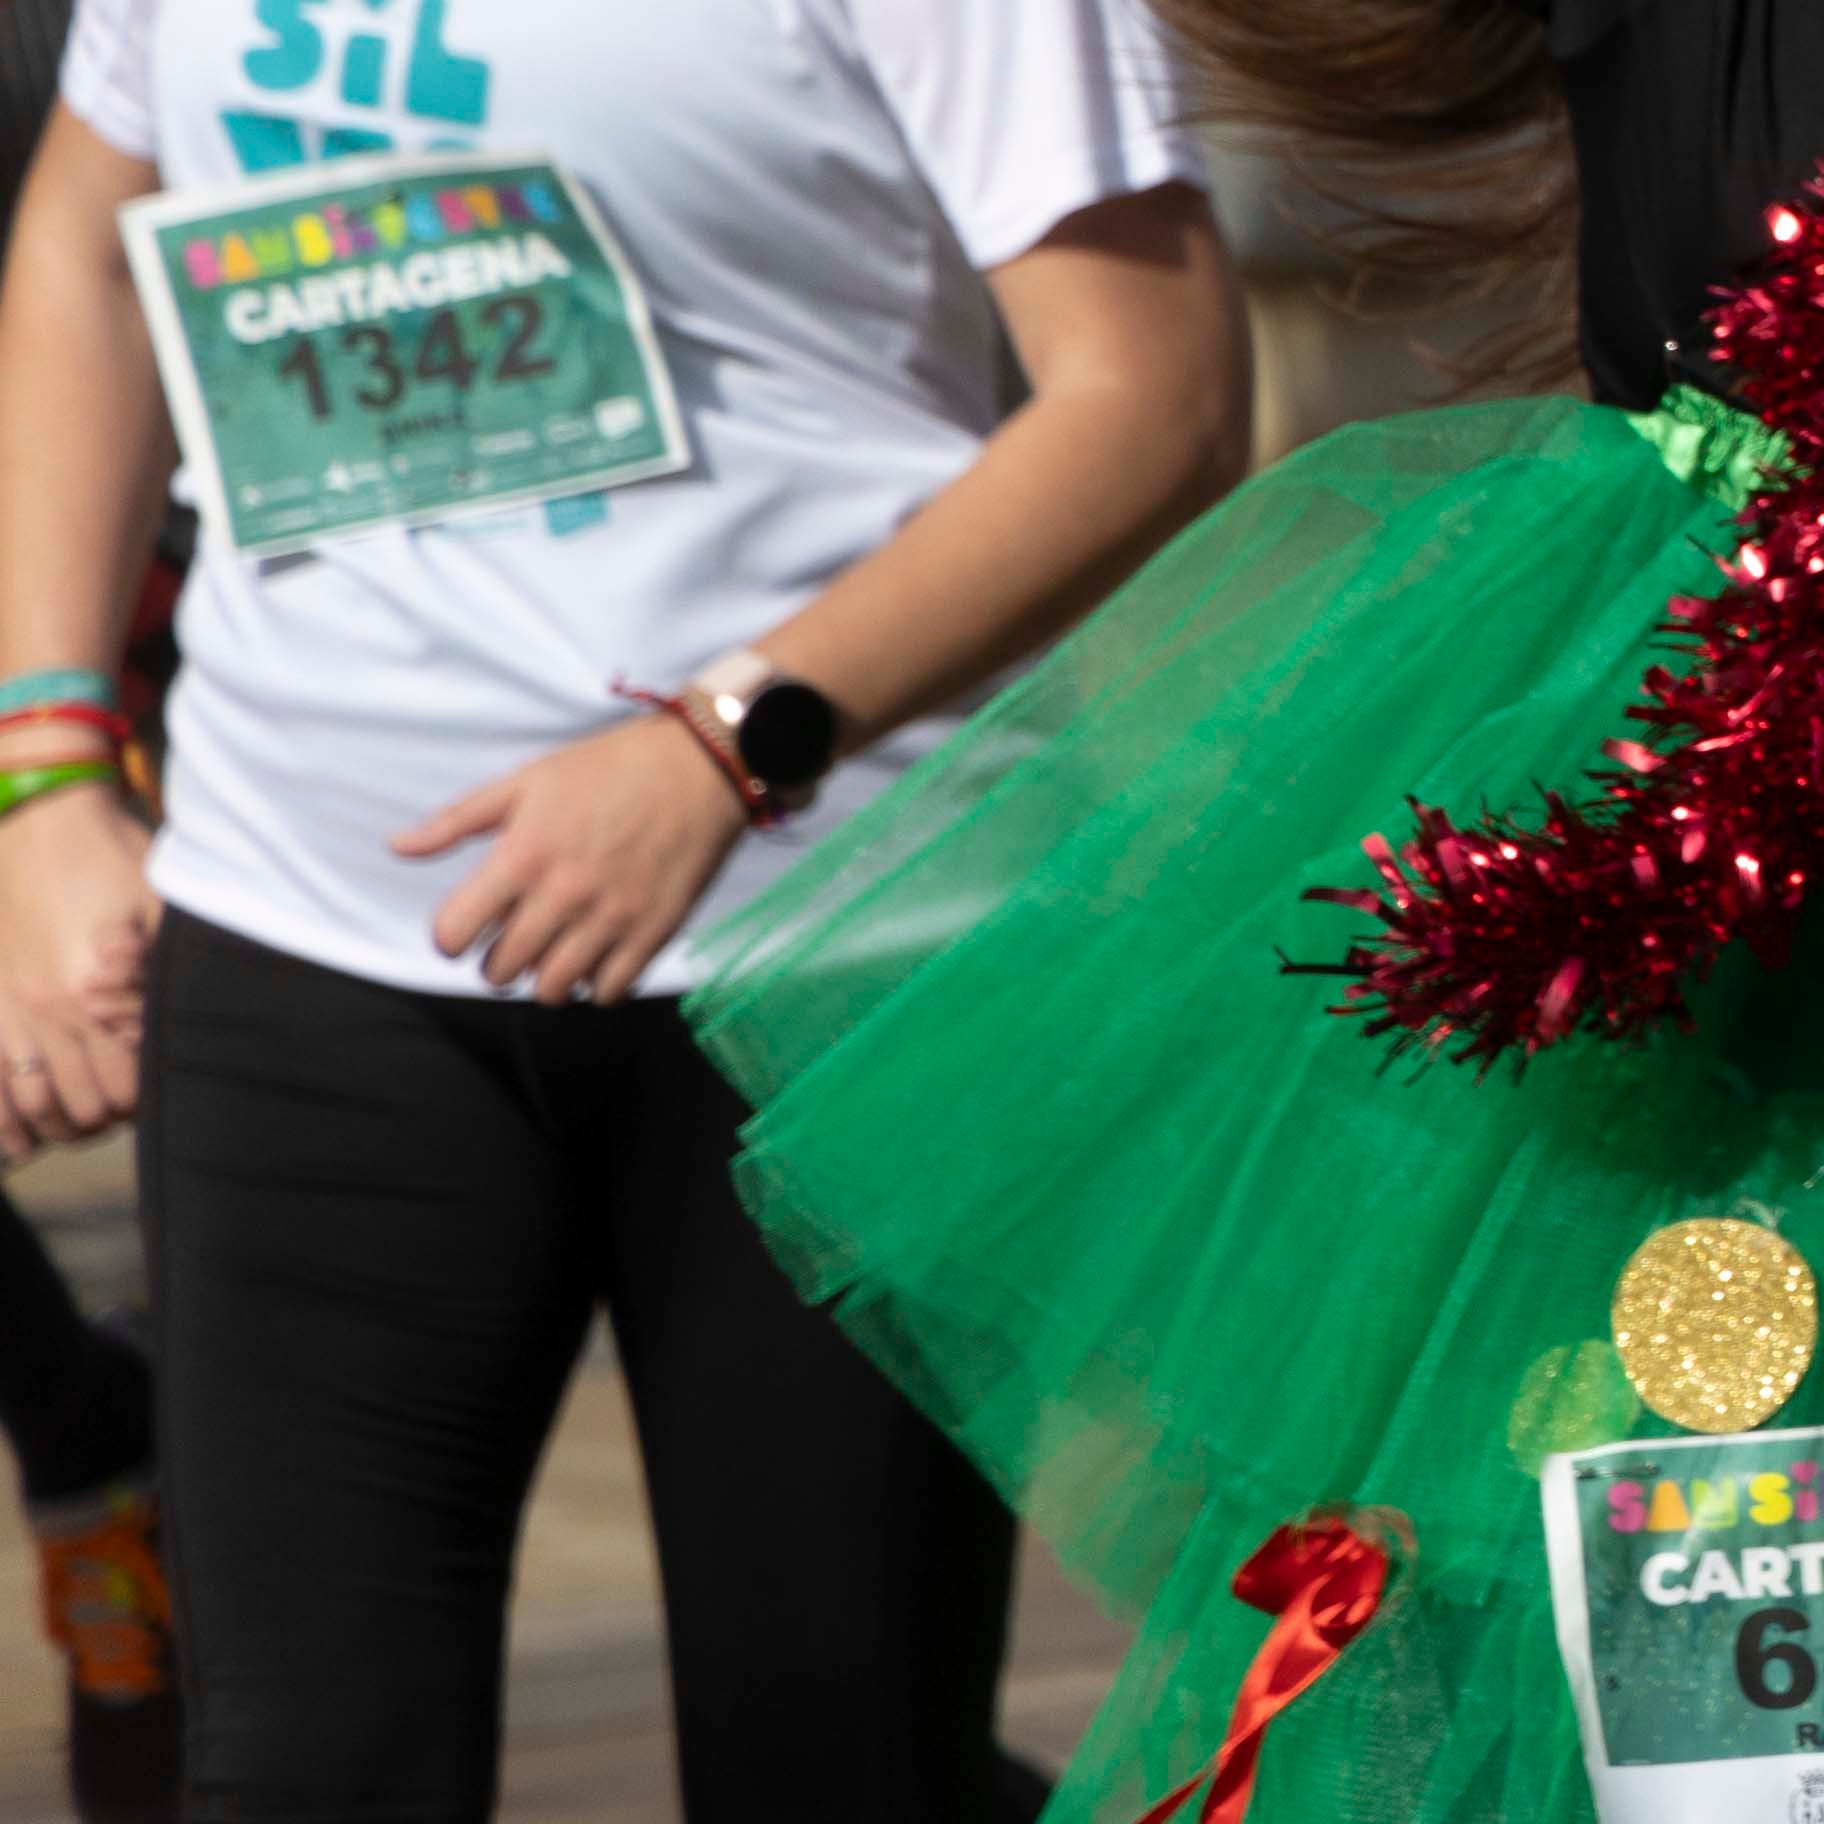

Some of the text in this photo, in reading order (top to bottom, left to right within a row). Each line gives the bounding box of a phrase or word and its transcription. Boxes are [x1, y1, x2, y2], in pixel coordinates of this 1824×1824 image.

[225, 232, 572, 343] CARTAGENA
[277, 295, 557, 422] 1342
[1607, 1479, 1737, 1533] SAN
